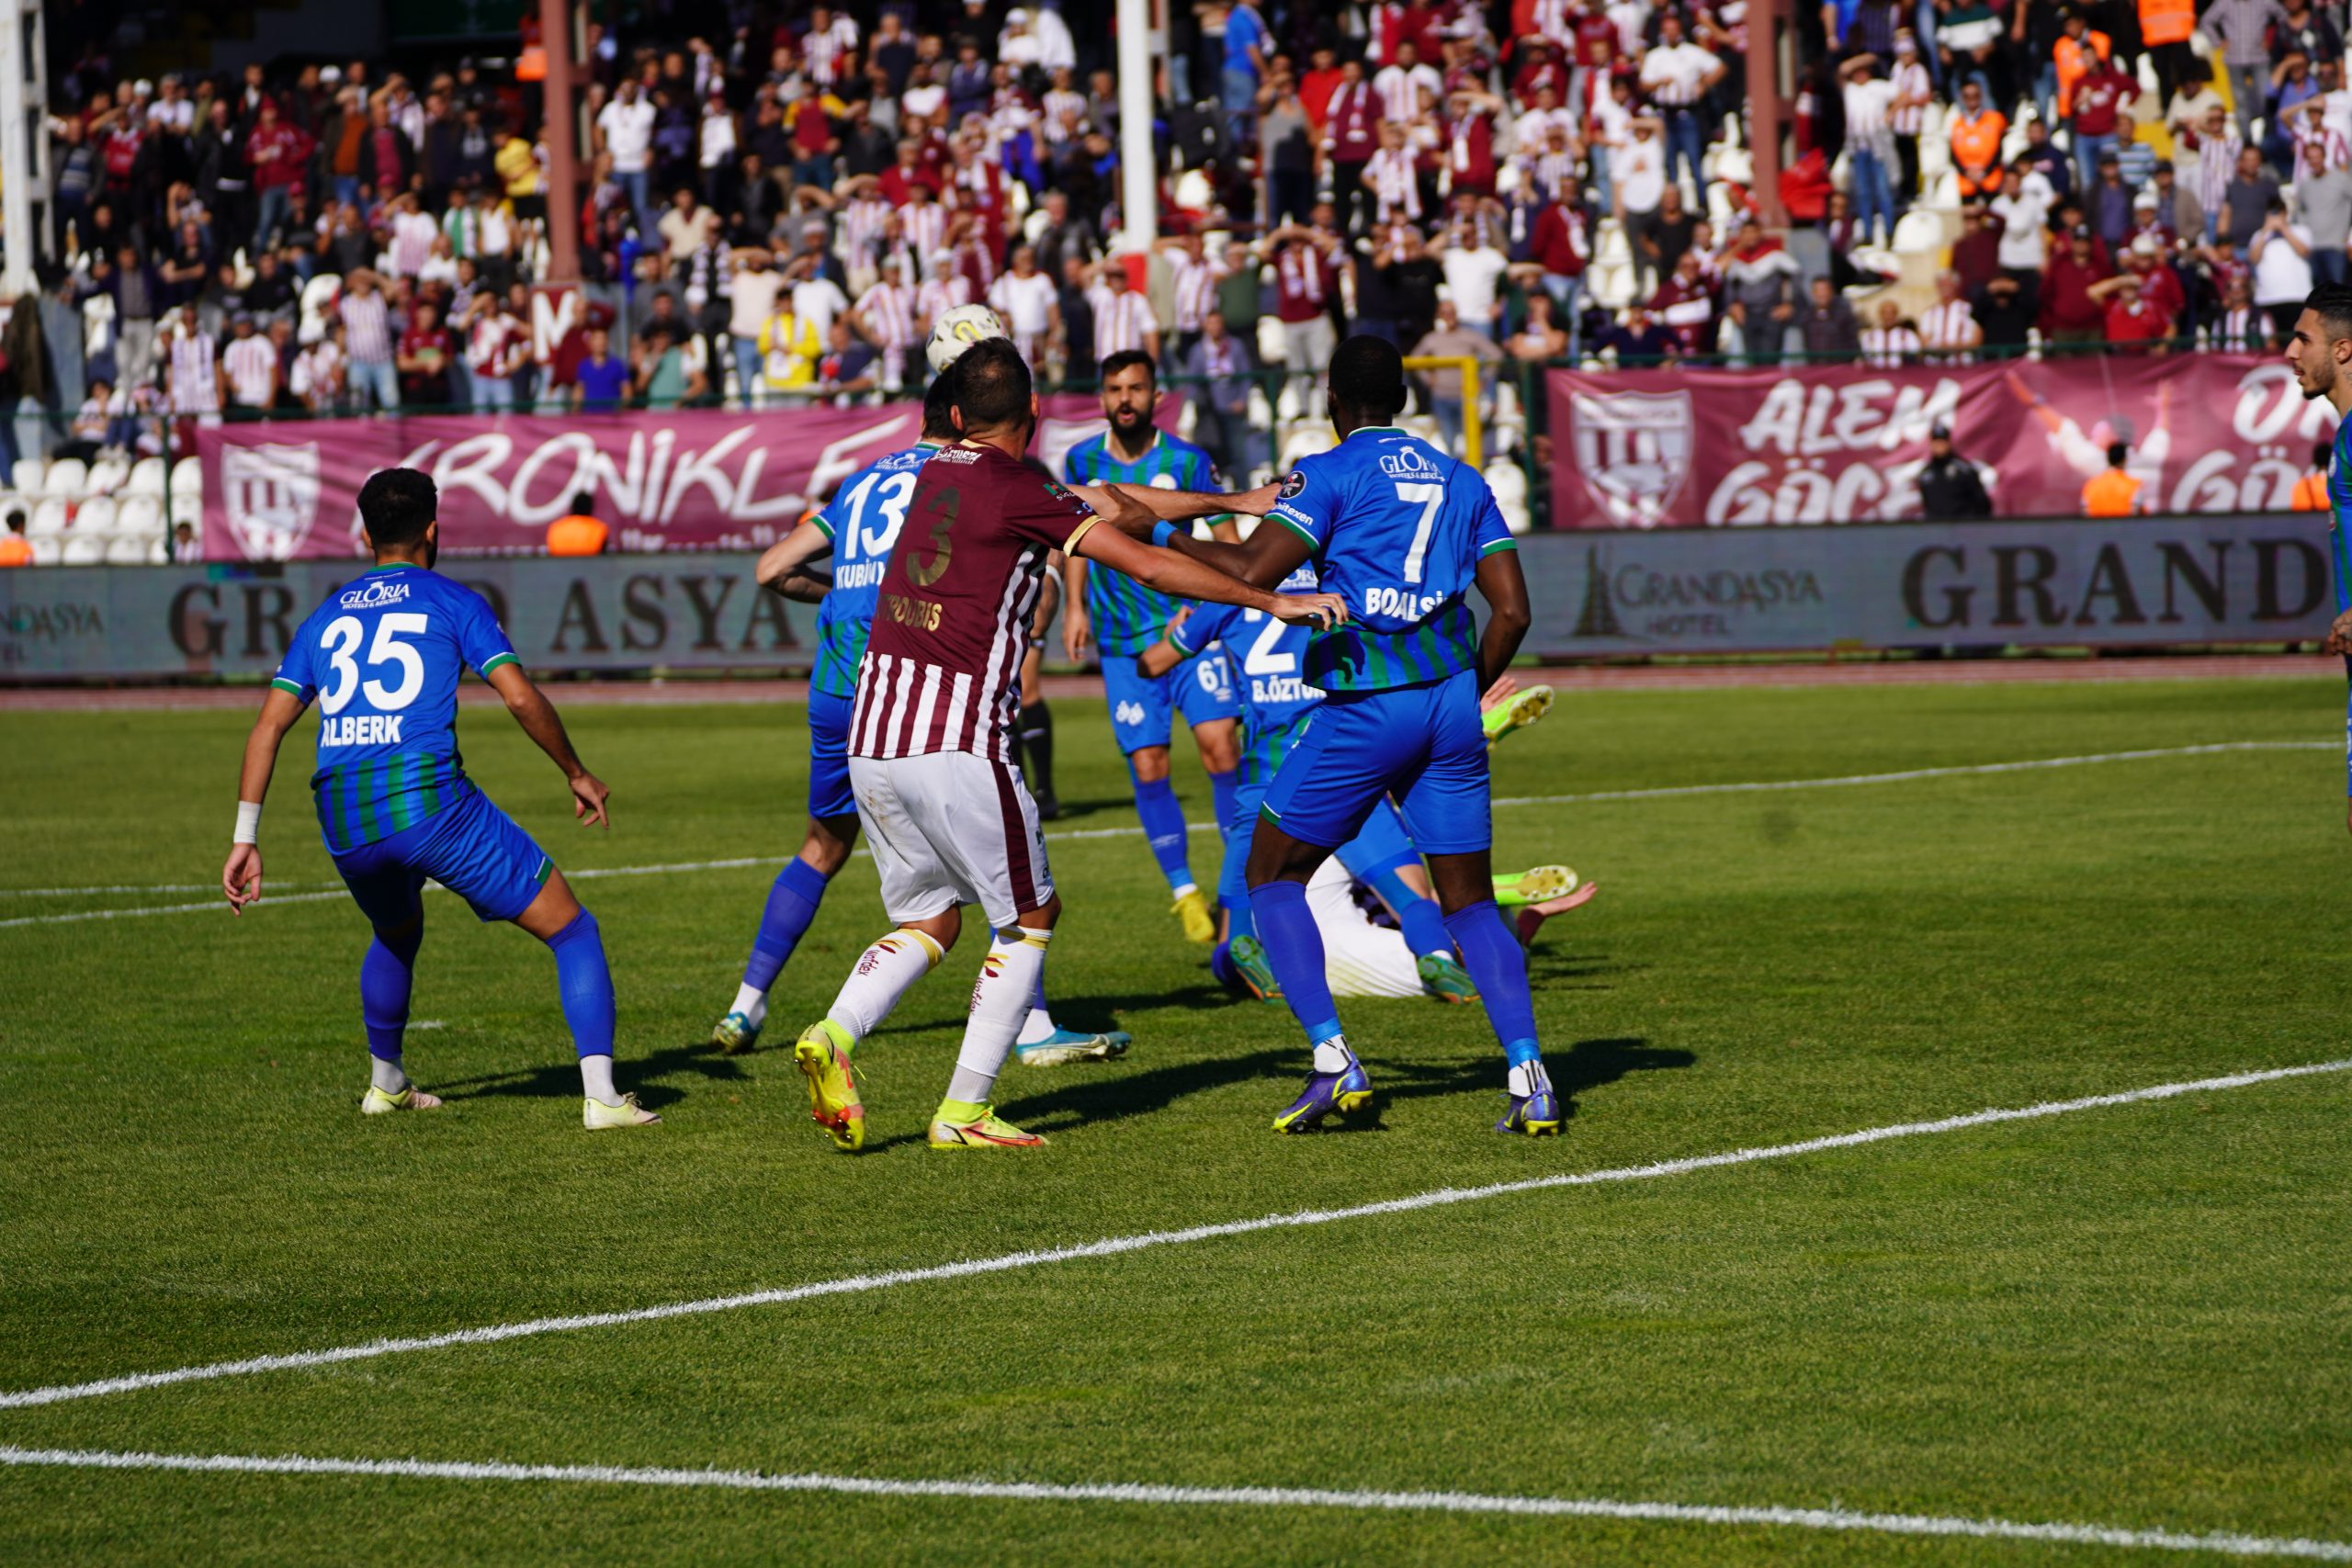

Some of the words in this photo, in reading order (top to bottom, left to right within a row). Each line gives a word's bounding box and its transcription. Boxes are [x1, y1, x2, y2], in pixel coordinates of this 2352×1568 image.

[843, 471, 918, 559] 13
[1395, 481, 1444, 584] 7
[339, 581, 411, 604] GLORIA
[549, 576, 797, 652] ASYA
[1615, 563, 1824, 613] GRANDASYA
[1902, 537, 2329, 629] GRAND
[1244, 607, 1295, 675] 2
[1650, 613, 1731, 637] HOTEL
[319, 613, 428, 715] 35
[1196, 656, 1229, 694] 67
